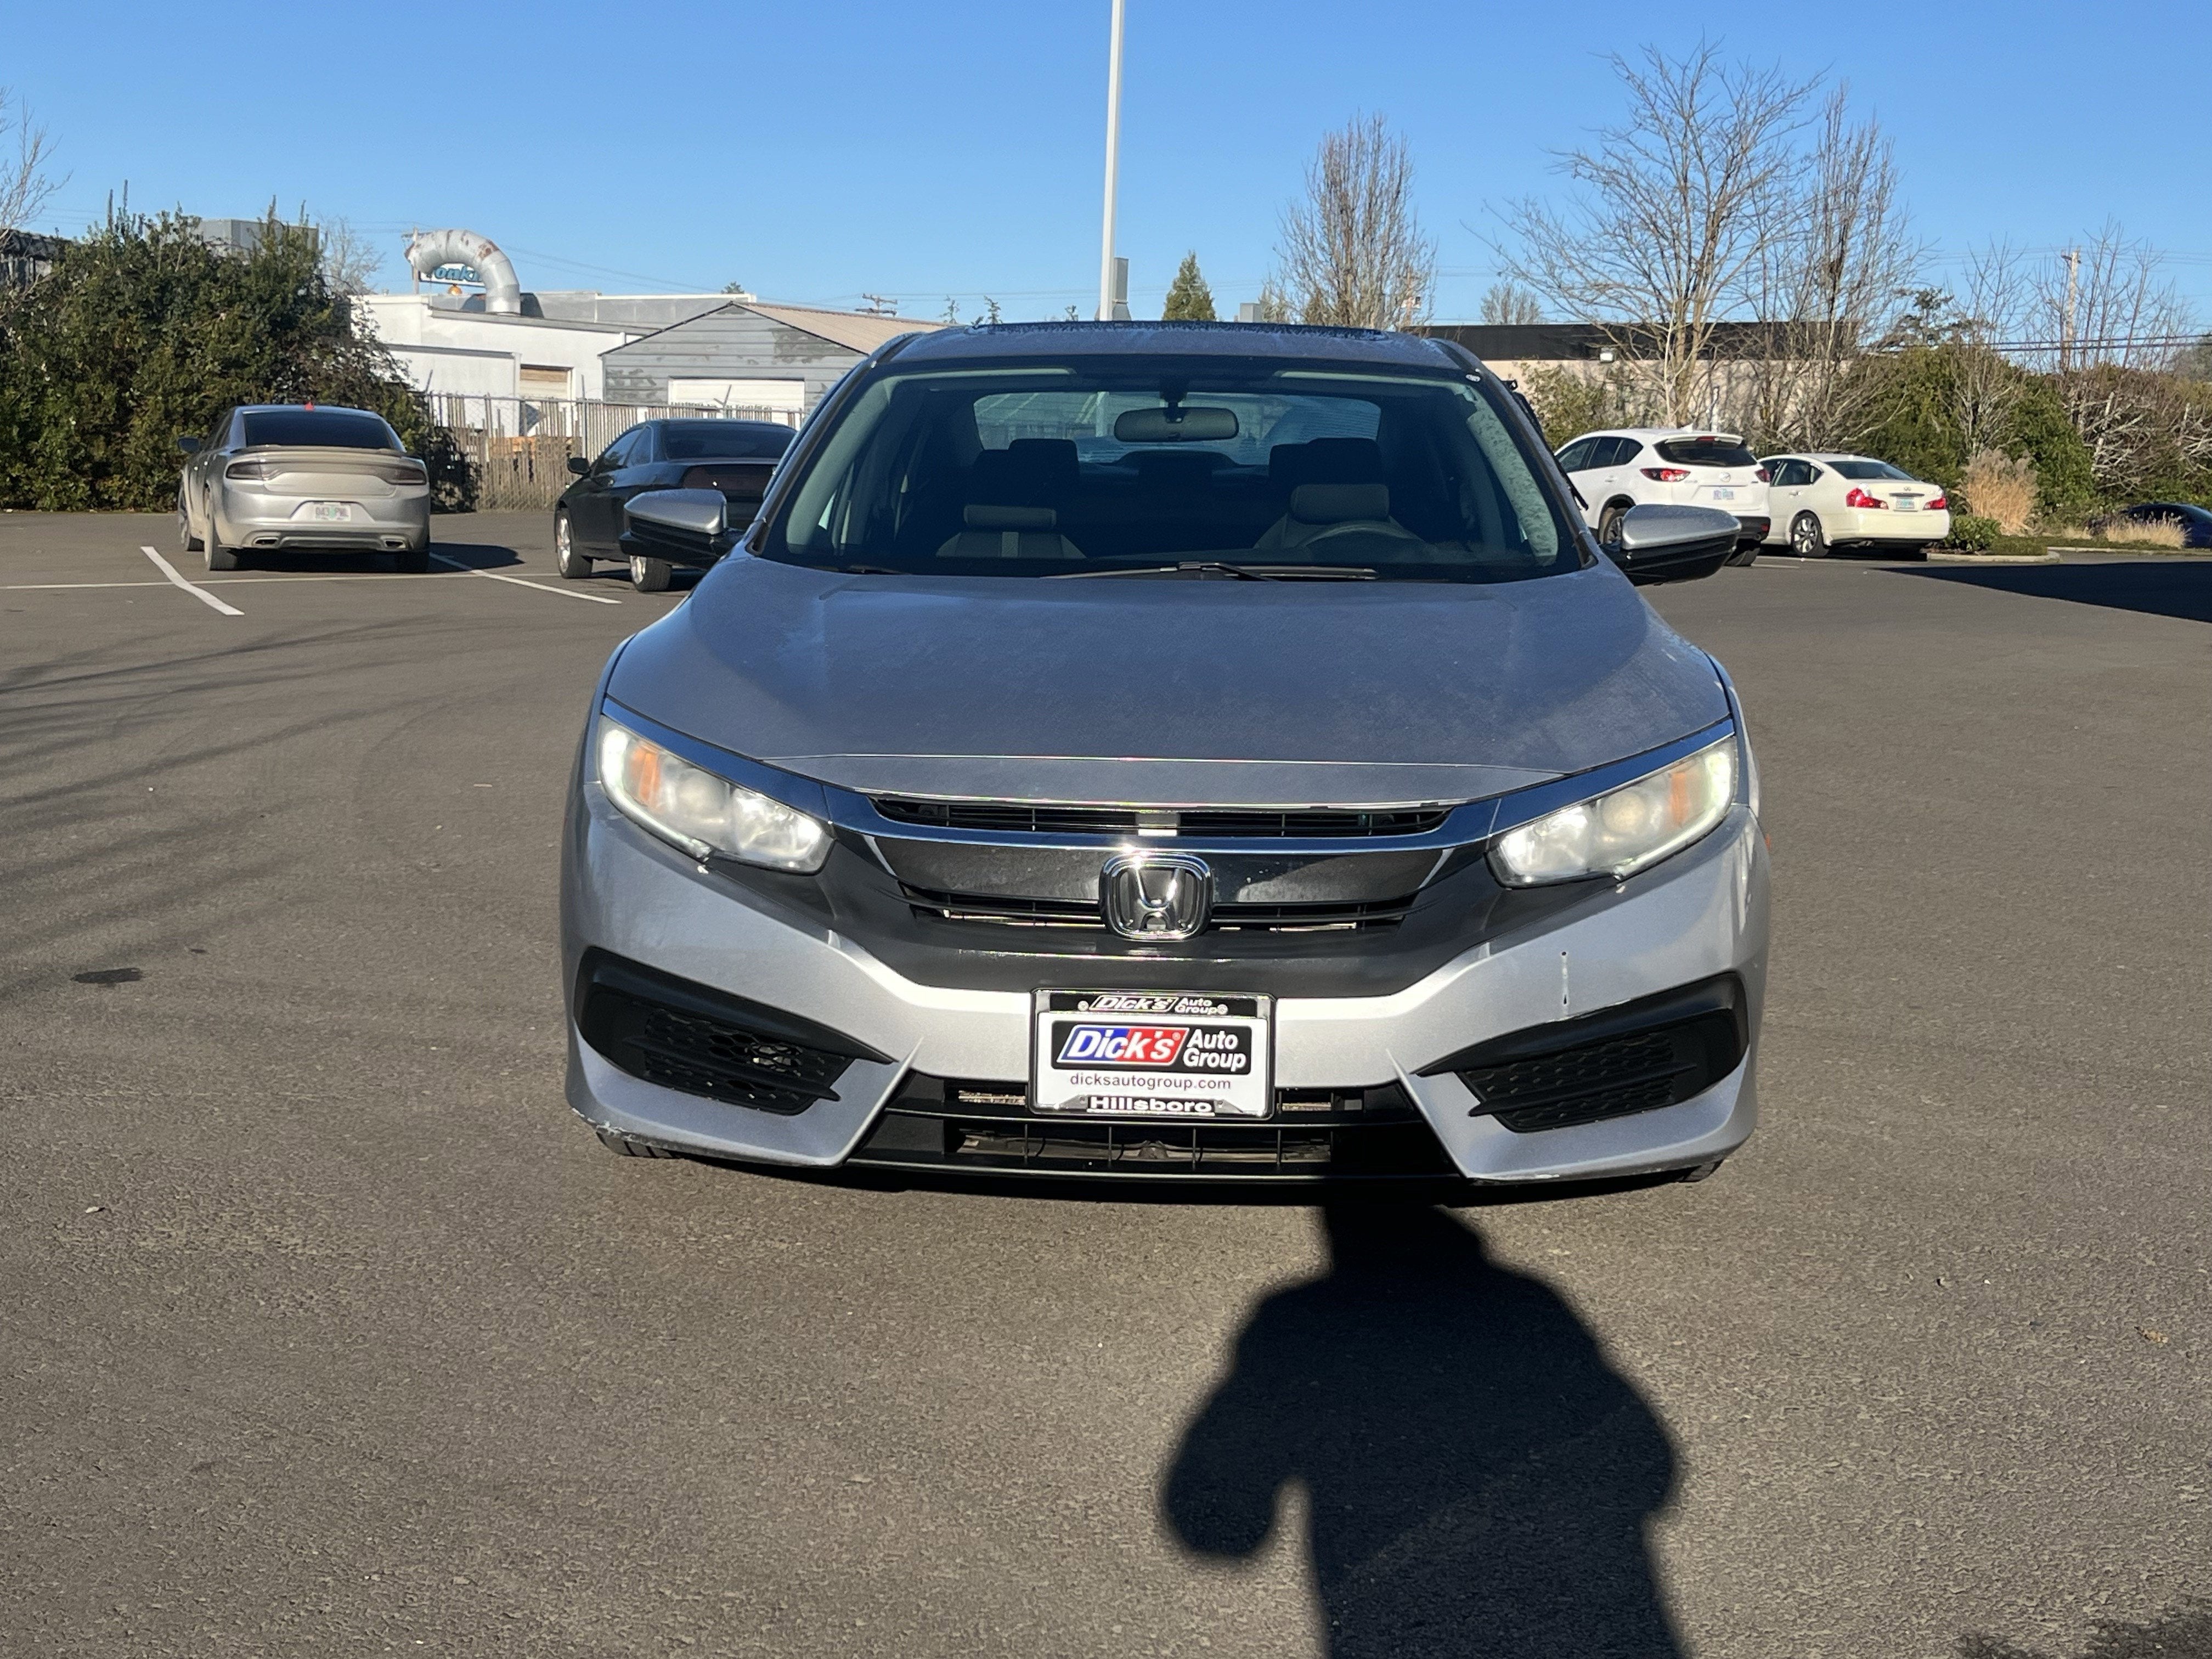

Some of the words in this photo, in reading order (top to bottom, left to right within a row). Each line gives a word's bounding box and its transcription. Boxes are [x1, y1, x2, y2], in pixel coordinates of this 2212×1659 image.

[1178, 997, 1212, 1006] Auto
[1175, 1005, 1217, 1015] Group
[1187, 1029, 1238, 1050] Auto
[1183, 1051, 1246, 1071] Group
[1070, 1073, 1231, 1090] dicksautogroup.com
[1090, 1097, 1212, 1113] Hillsboro
